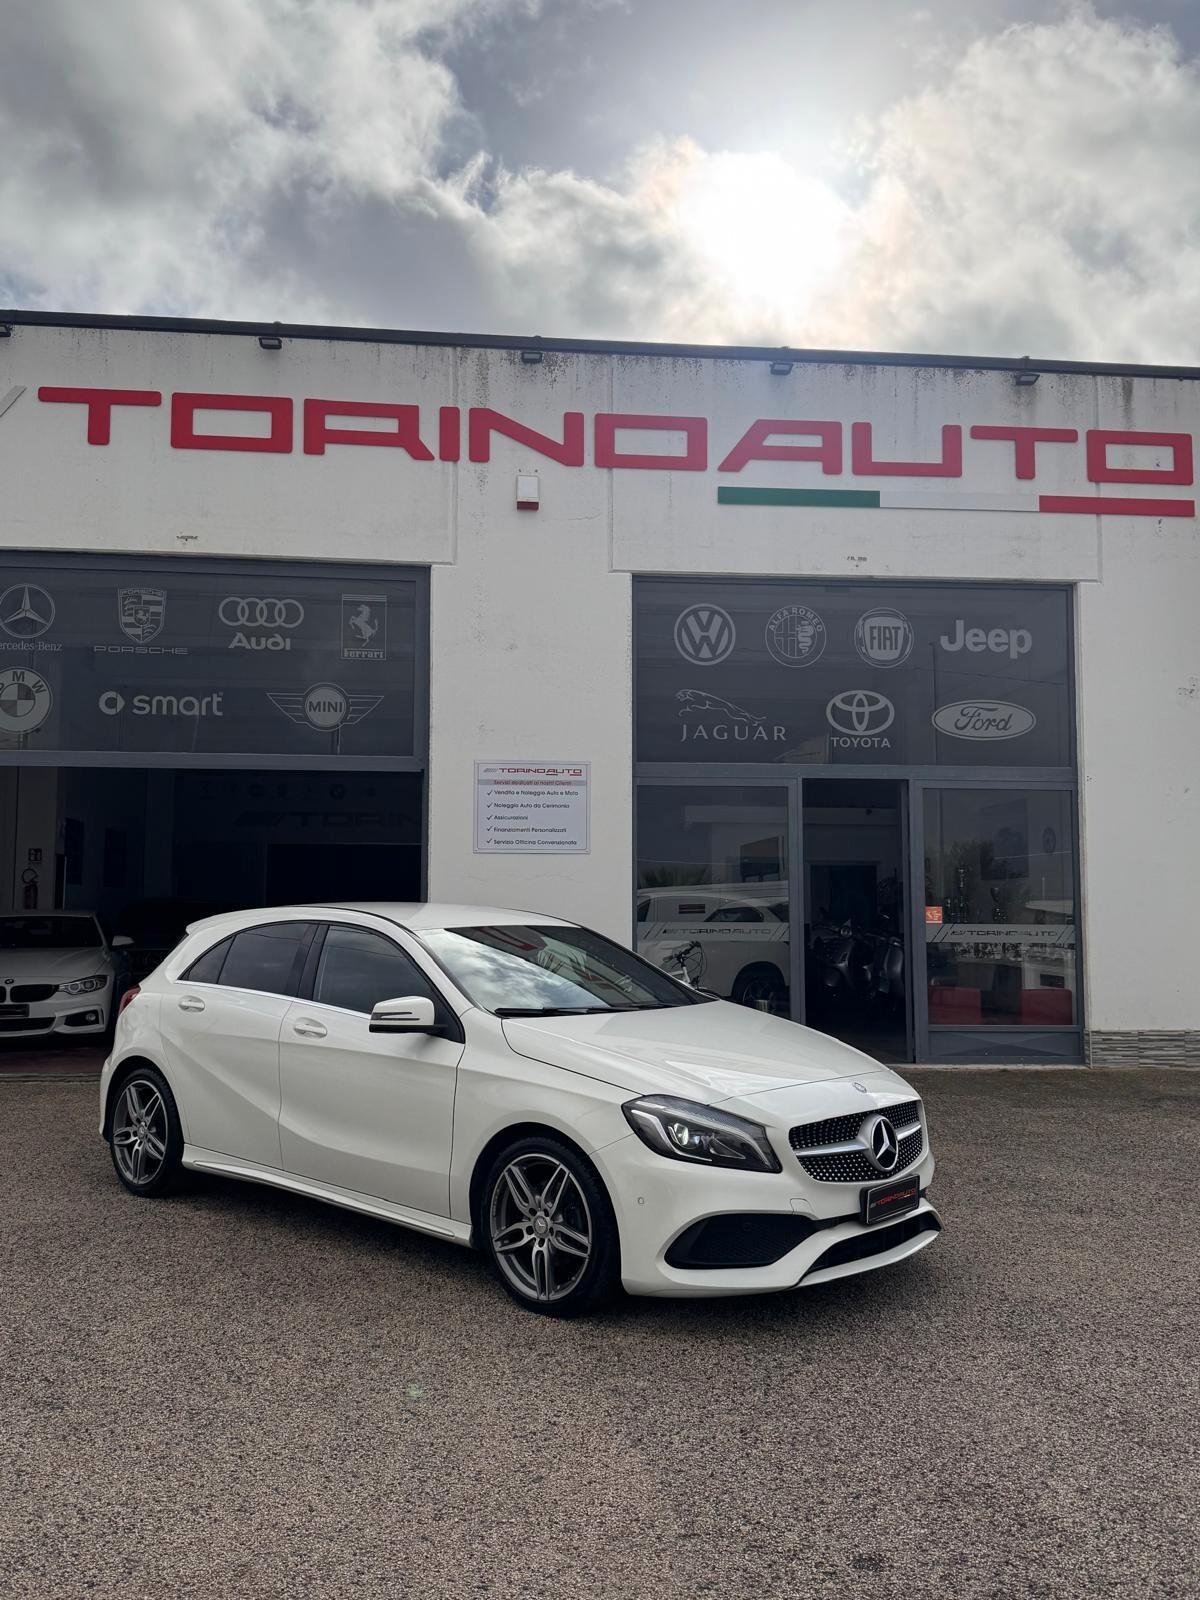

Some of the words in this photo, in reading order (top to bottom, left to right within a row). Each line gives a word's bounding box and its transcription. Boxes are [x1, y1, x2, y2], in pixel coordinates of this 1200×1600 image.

[38, 386, 1194, 486] TORINOAUTO
[768, 608, 790, 632] ALFA
[791, 607, 824, 633] ROMEO
[228, 632, 291, 650] Audi
[869, 625, 901, 651] FIAT
[940, 619, 1033, 660] Jeep
[94, 645, 189, 655] PORSCHE
[343, 648, 384, 659] Ferrari
[132, 692, 224, 716] smart
[308, 701, 343, 713] MINI
[954, 705, 1014, 732] Ford
[680, 724, 787, 742] JAGUAR
[830, 737, 892, 749] TOYOTA
